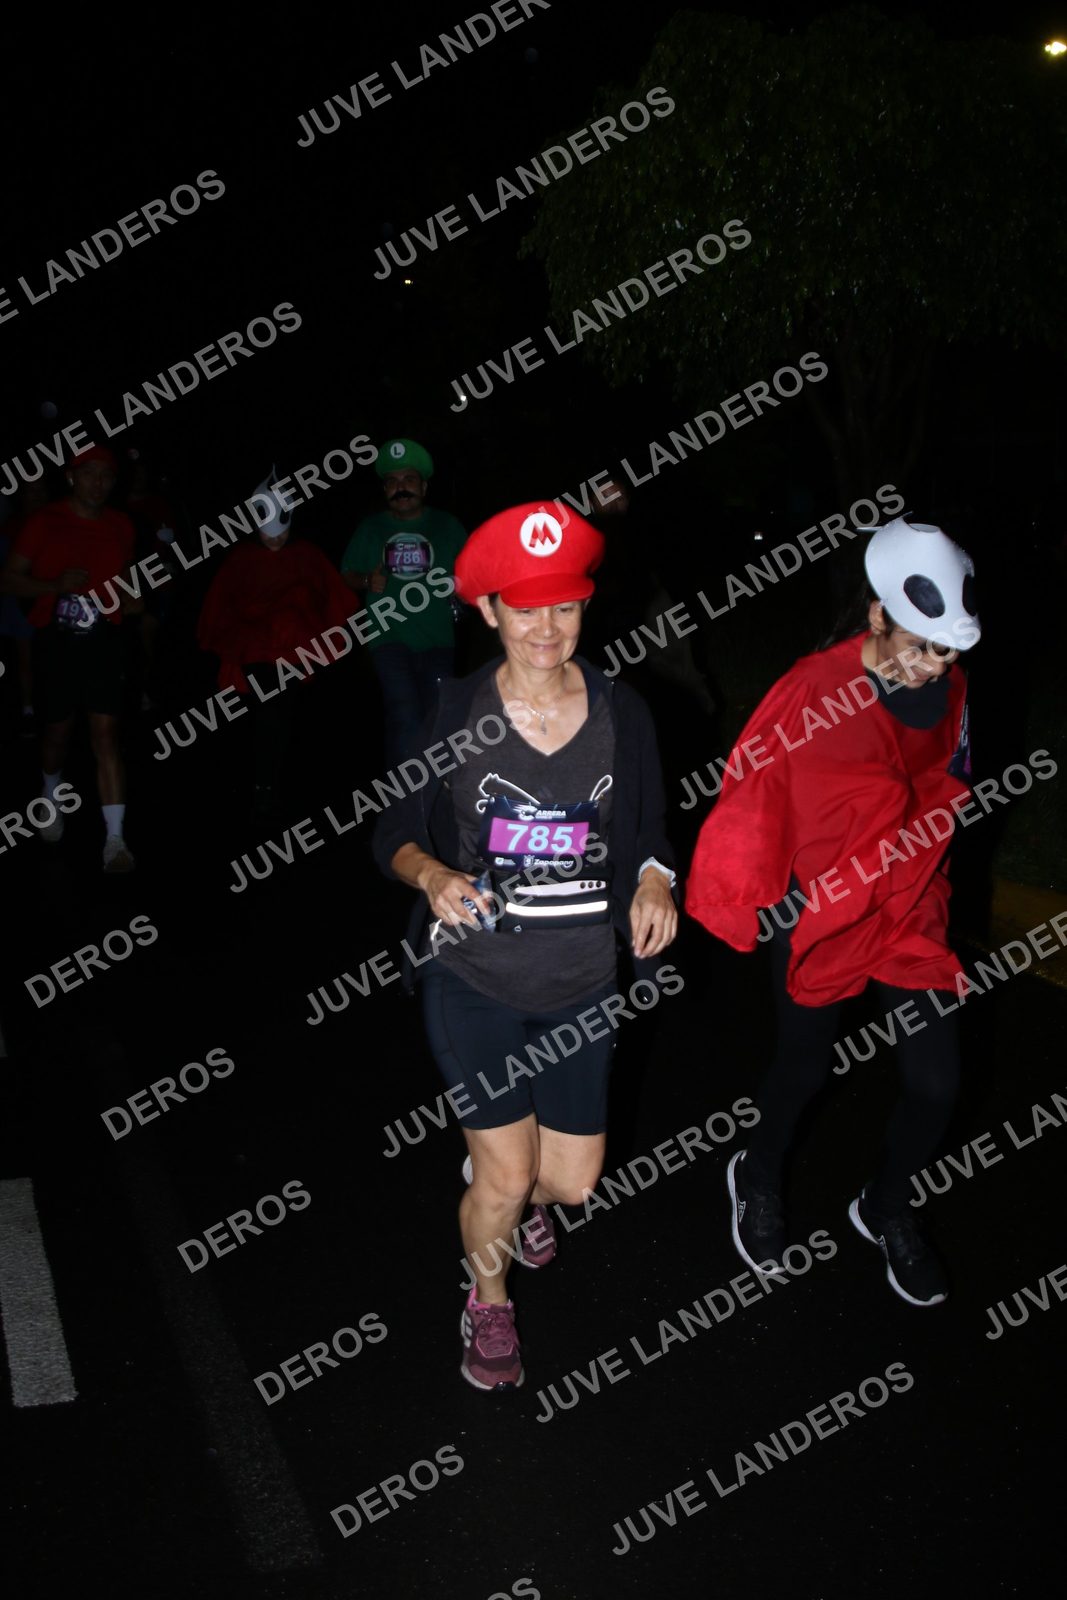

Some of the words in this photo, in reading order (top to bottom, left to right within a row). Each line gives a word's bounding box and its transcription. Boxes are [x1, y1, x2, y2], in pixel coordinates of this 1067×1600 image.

[393, 446, 402, 456] L
[529, 520, 557, 549] M
[394, 551, 421, 564] 786
[507, 823, 574, 852] 785
